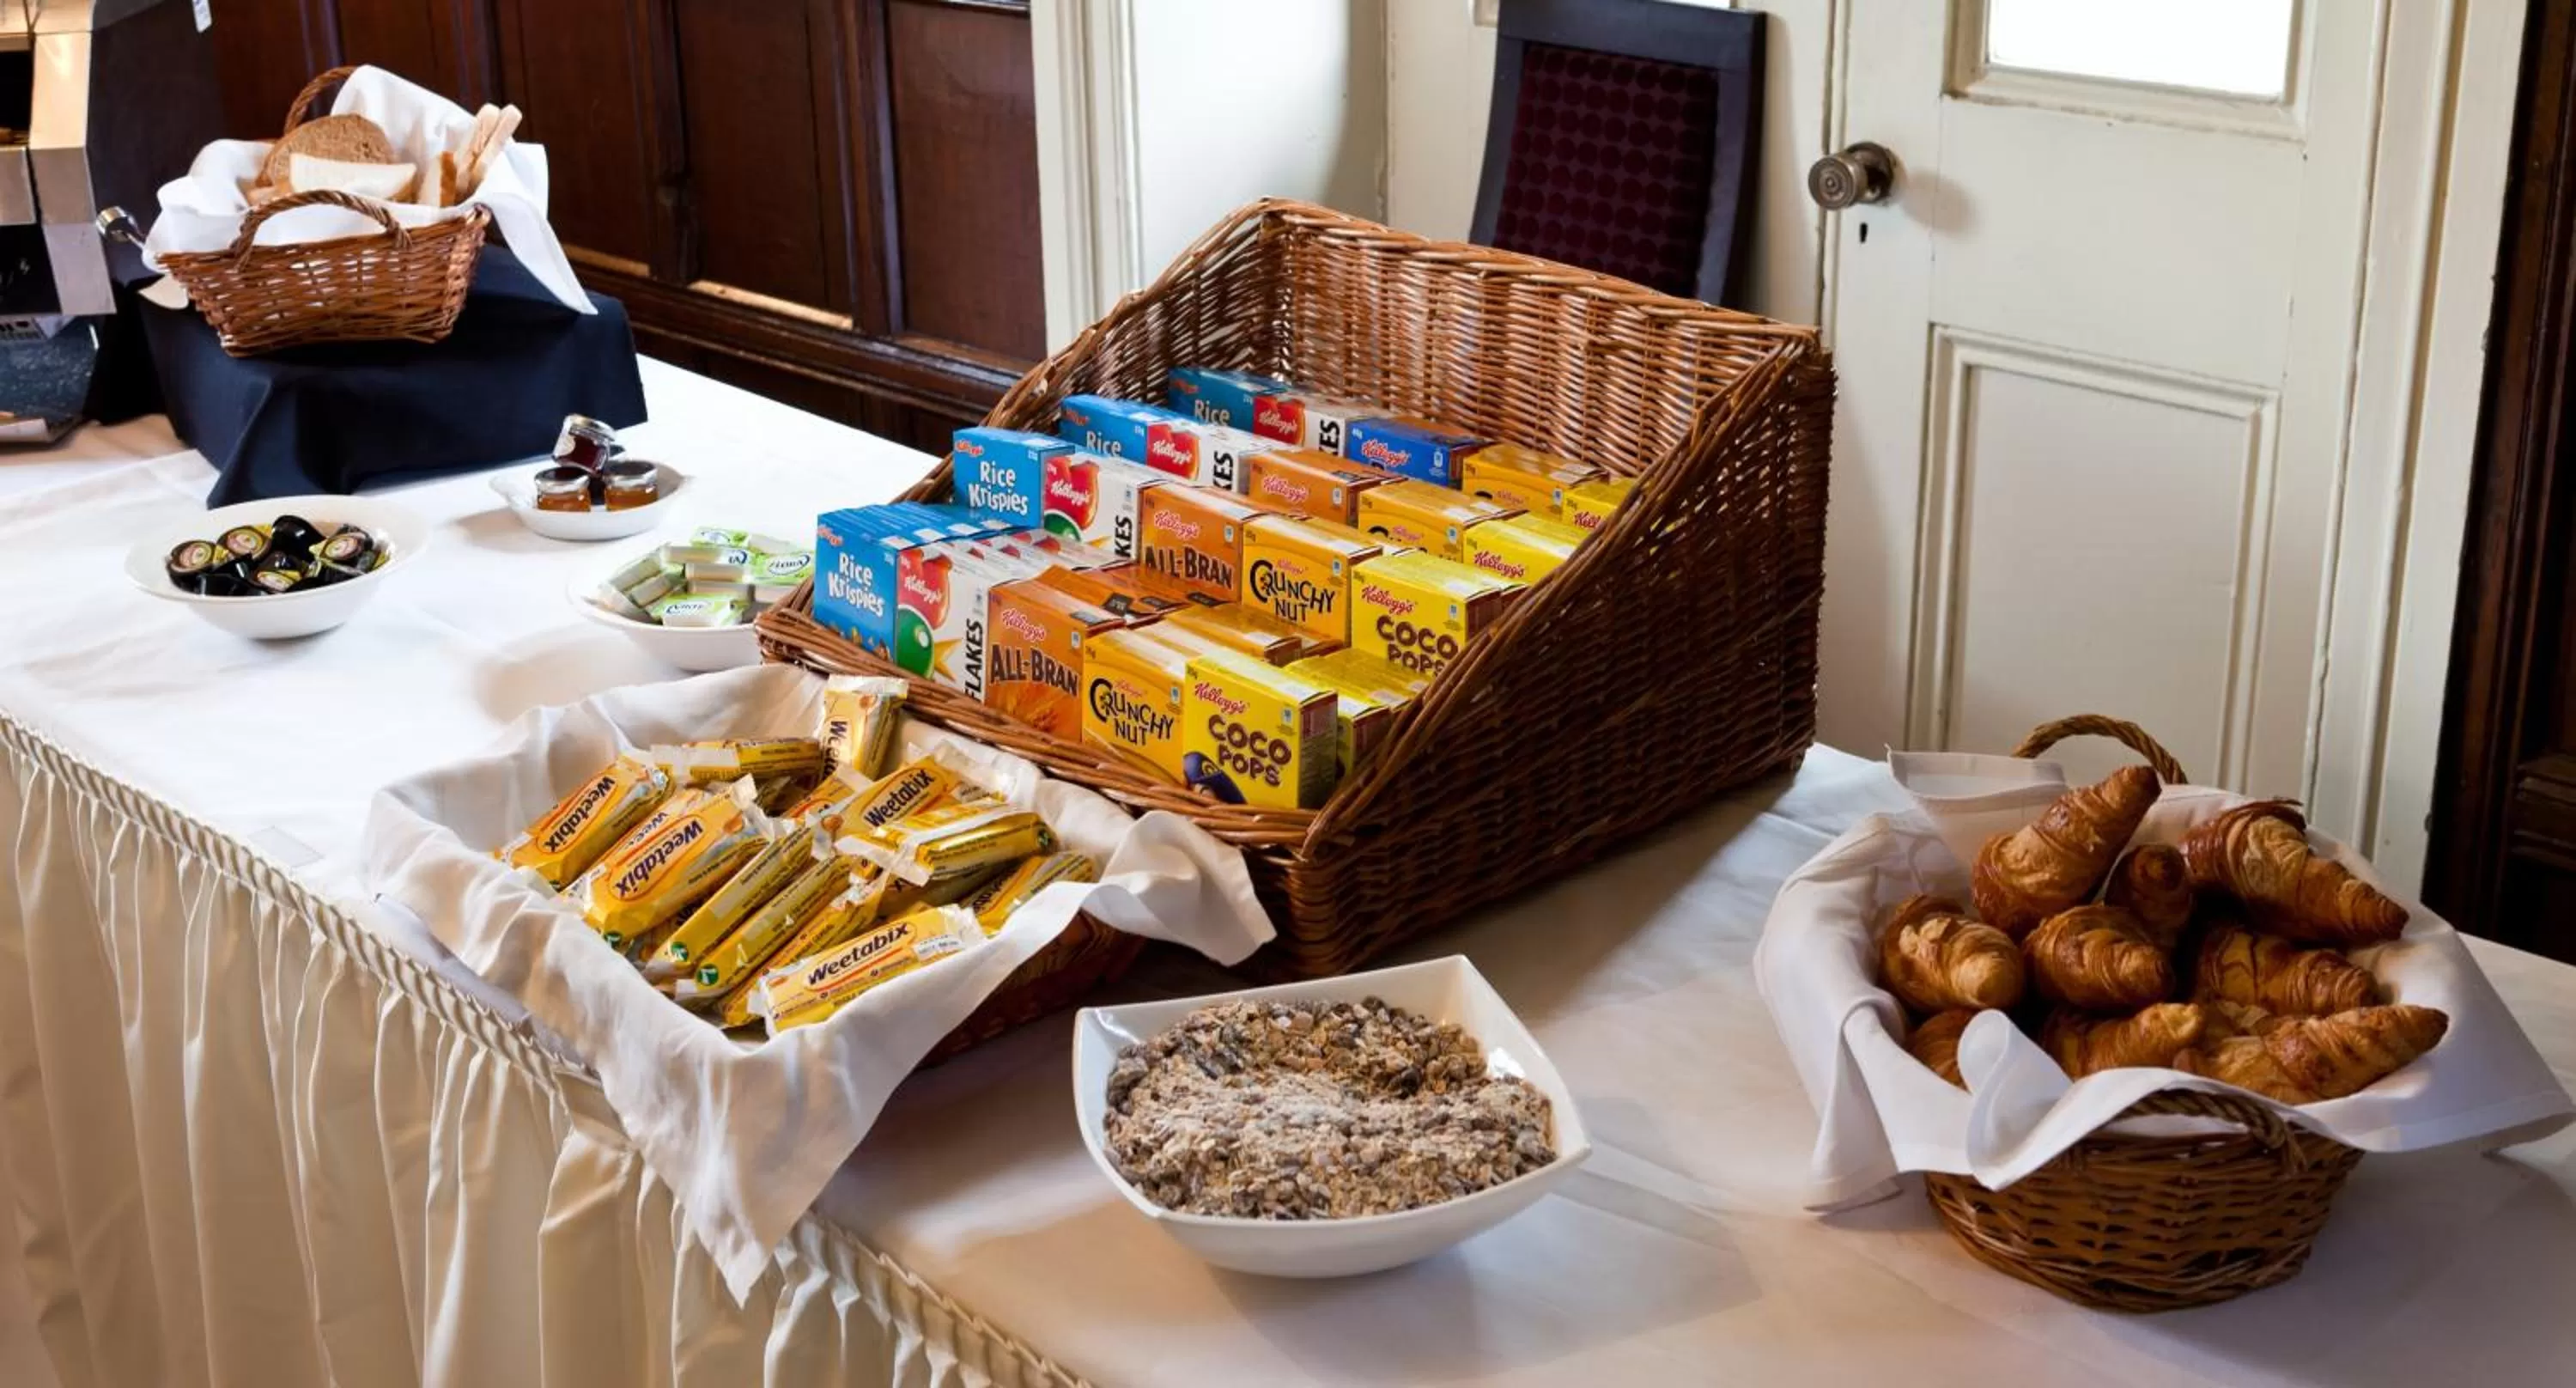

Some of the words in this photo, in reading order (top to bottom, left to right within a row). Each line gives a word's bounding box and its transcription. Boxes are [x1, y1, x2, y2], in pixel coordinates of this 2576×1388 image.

[1194, 399, 1230, 426] Rice
[1085, 430, 1122, 457] Rice
[1152, 439, 1192, 465] Kellogg's
[979, 460, 1017, 487] Rice
[968, 483, 1029, 515] Krispies
[1050, 479, 1090, 506] Kellogg's
[1115, 514, 1133, 557] KES
[1154, 508, 1200, 541] Kellogg's
[838, 552, 873, 587] Rice
[1144, 545, 1234, 591] ALL-BRAN
[1473, 550, 1525, 579] Kellogg's
[828, 571, 884, 618] Krispies
[903, 574, 943, 604] Kellogg's
[1249, 559, 1335, 614] CRUNCHY
[1362, 583, 1415, 616] Kellogg's
[1001, 607, 1048, 642] Kellogg's
[1275, 598, 1308, 622] NUT
[1376, 614, 1460, 661] COCO
[989, 643, 1079, 697] ALL-BRAN
[1090, 678, 1174, 740] CRUNCHY
[1194, 682, 1246, 715] Kellogg's
[1115, 718, 1146, 746] NUT
[1208, 714, 1292, 765] COCO
[1217, 744, 1282, 788] POPS
[544, 776, 616, 853] Weetabix
[863, 769, 936, 828] Weetabix
[614, 819, 704, 897] Weetabix
[808, 922, 909, 986] Weetabix
